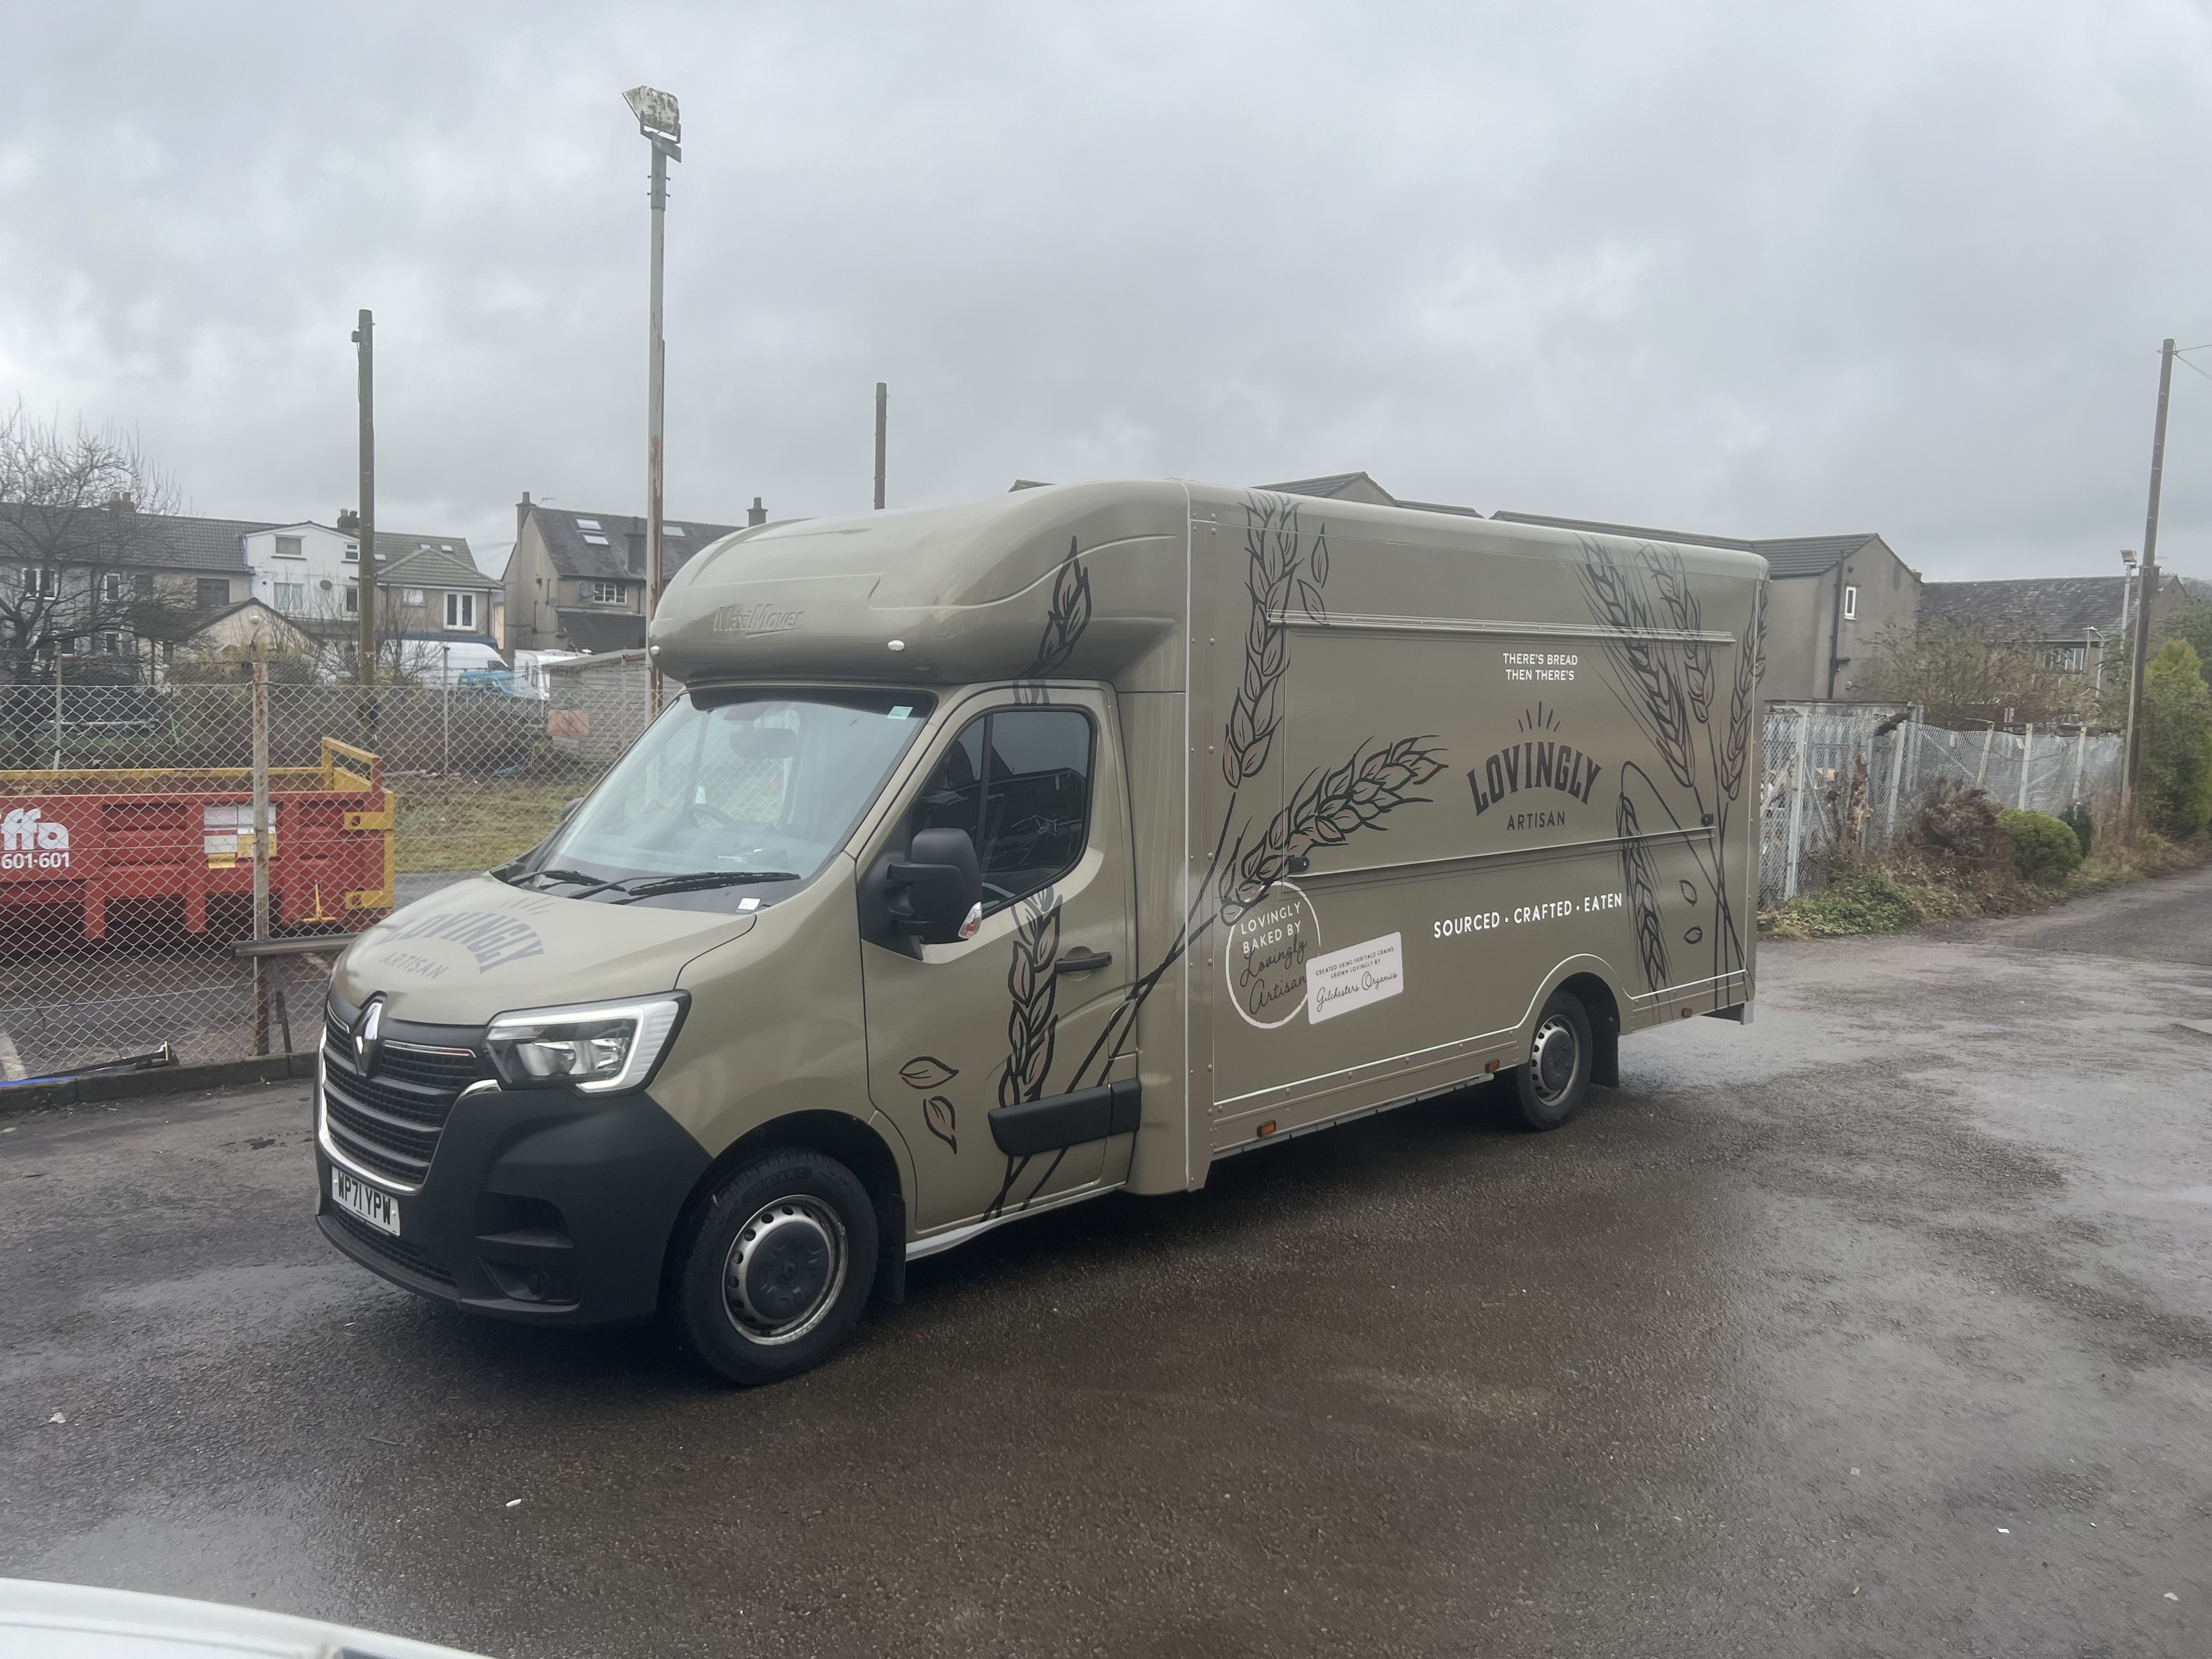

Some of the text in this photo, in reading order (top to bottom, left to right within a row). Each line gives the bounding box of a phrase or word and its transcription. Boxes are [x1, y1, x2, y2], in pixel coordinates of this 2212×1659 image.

[713, 604, 804, 631] MaxiMover
[1503, 652, 1578, 665] THERE'S BREAD
[1505, 669, 1575, 681] THEN THERE'S
[1466, 741, 1601, 817] LOVINGLY
[0, 808, 69, 851] ffa
[1506, 811, 1565, 831] ARTISAN
[1240, 901, 1301, 934] LOVINGLY
[1434, 893, 1622, 939] SOURCED CRAFTED EATEN
[373, 912, 544, 974] LOVINGLY
[1243, 921, 1301, 954] BAKED BY
[379, 951, 449, 980] ARTISAN
[1240, 933, 1307, 987] Lovingly
[1316, 946, 1394, 976] CREATED USING HERITAGE GRAINS
[1330, 969, 1348, 979] GROWN
[1350, 961, 1373, 973] LOVINGLY
[1250, 975, 1307, 1014] Artisan
[1362, 971, 1398, 991] Organics
